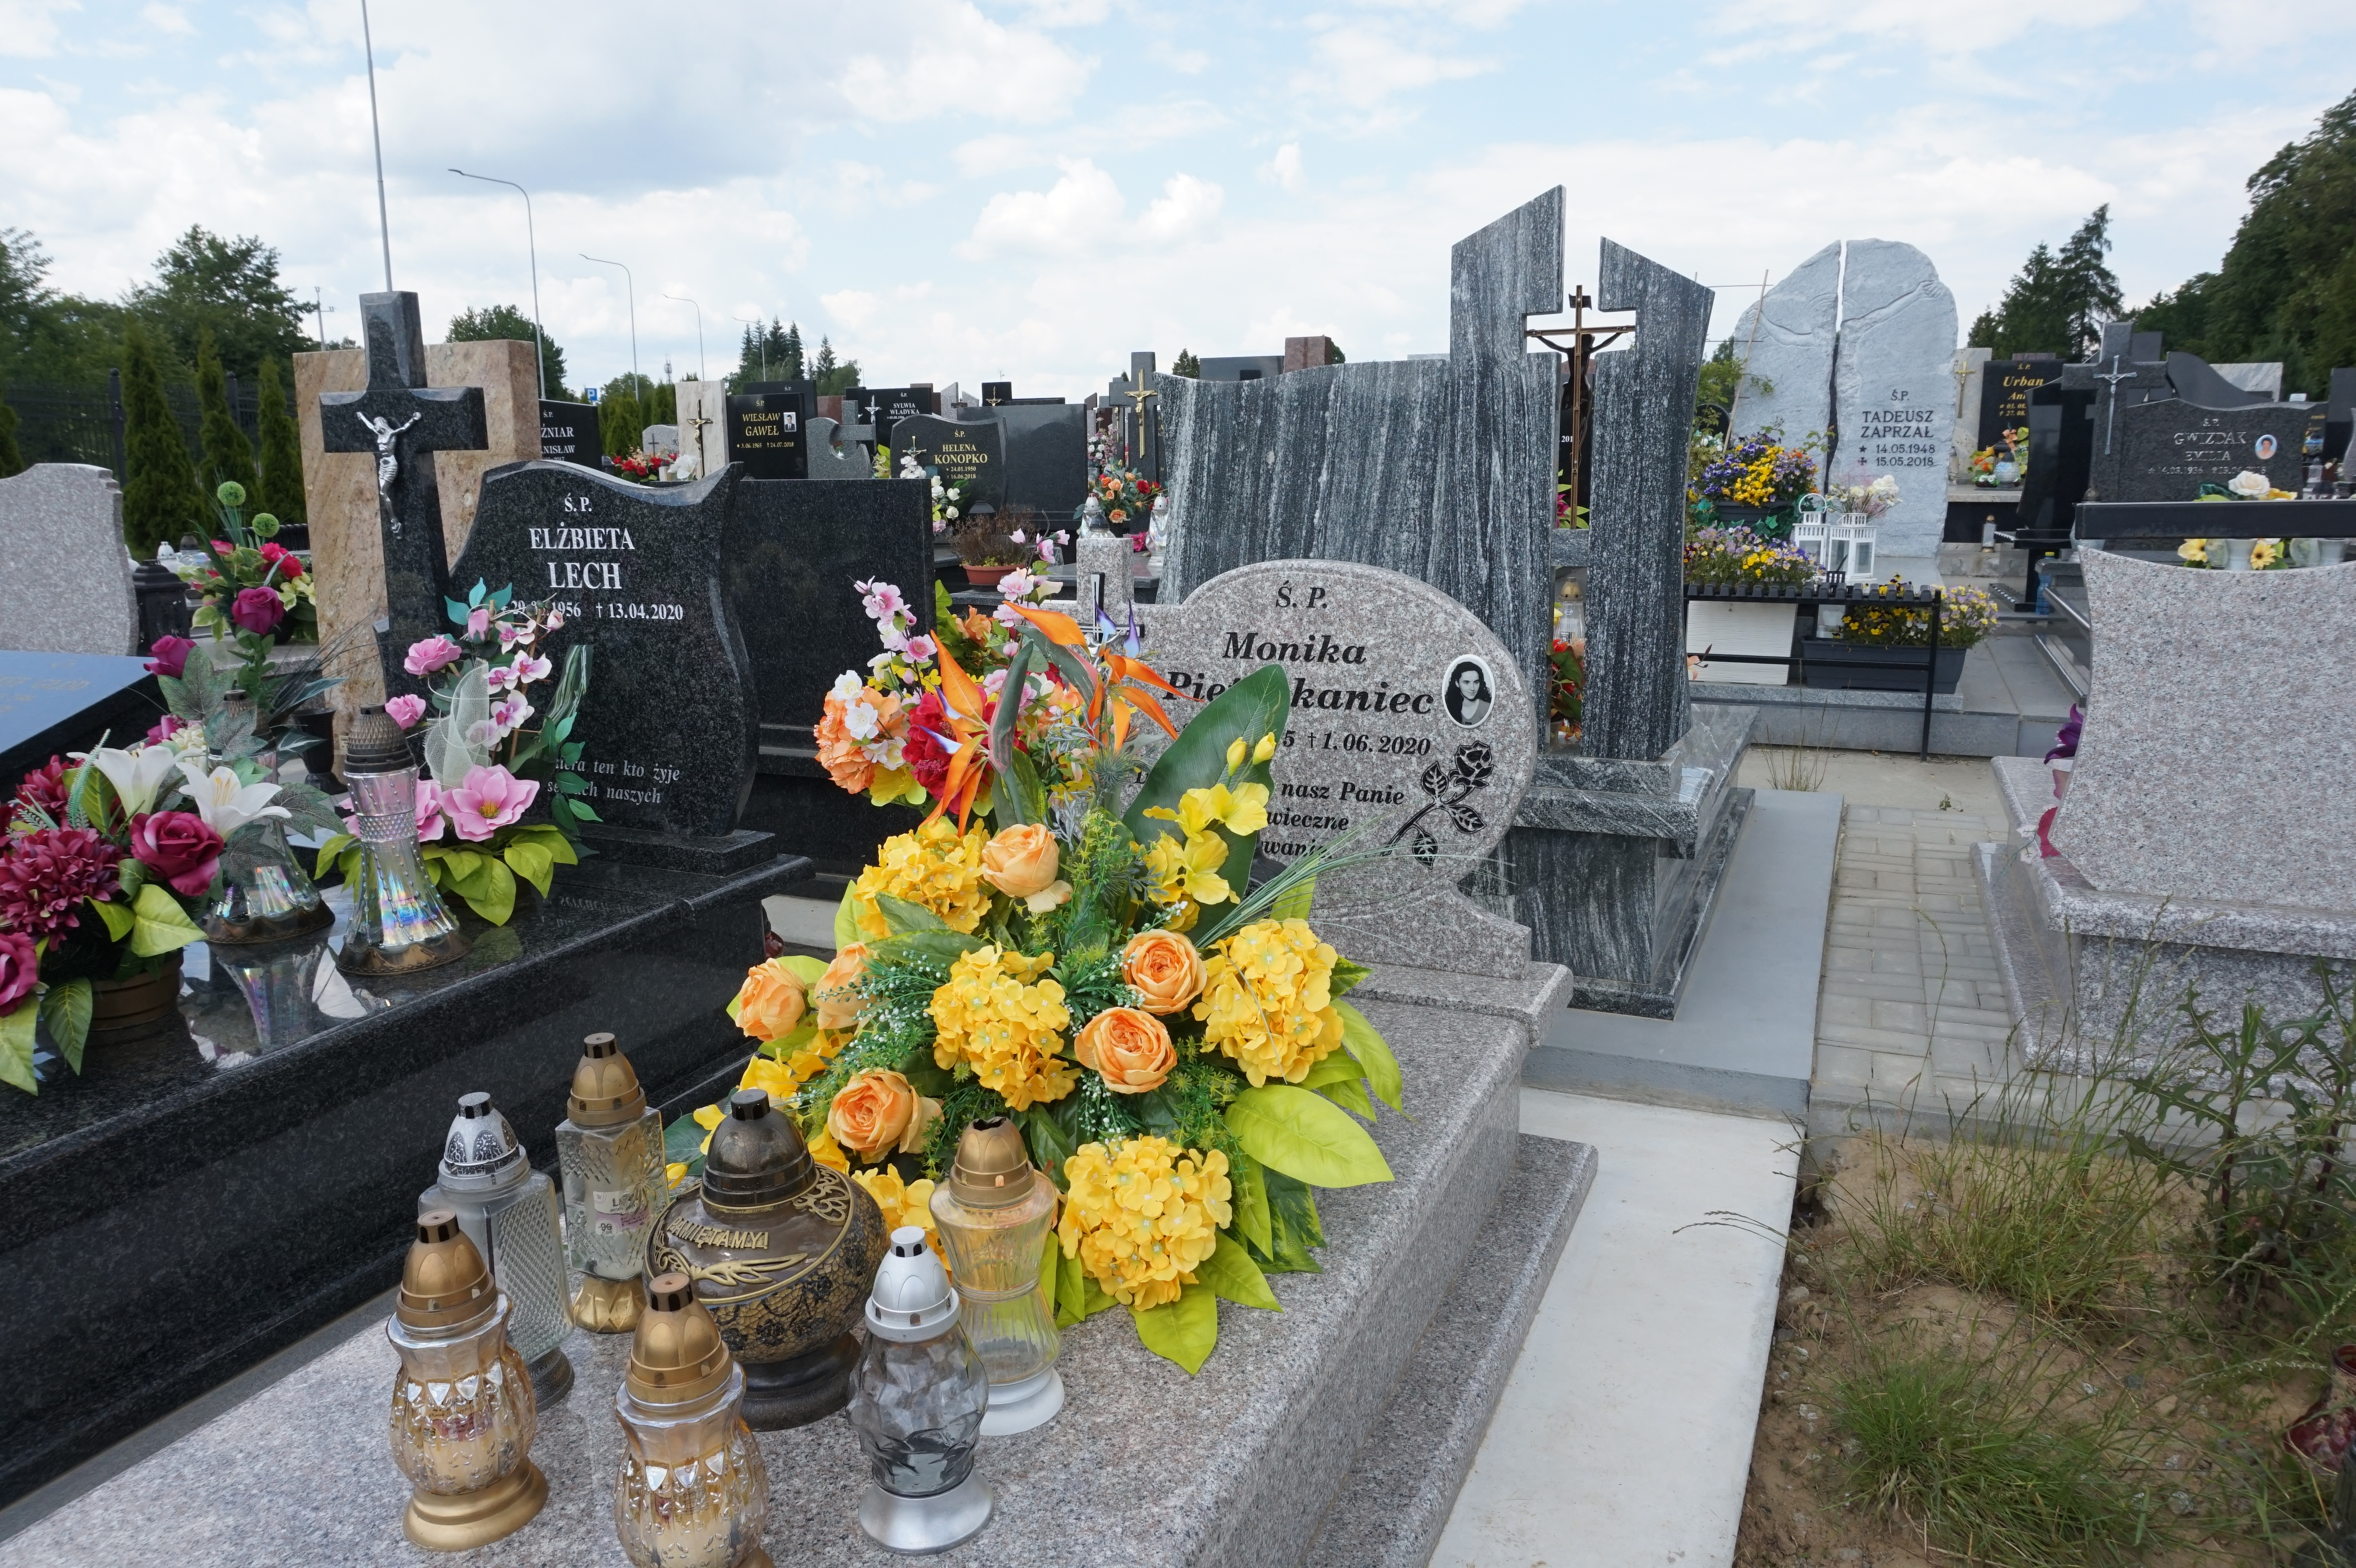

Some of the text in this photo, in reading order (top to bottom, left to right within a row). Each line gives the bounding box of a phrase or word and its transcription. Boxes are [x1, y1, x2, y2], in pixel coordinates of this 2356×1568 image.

[2003, 376, 2044, 387] Urban
[587, 389, 595, 399] P
[742, 412, 780, 422] WIESŁAW
[1862, 410, 1934, 423] TADEUSZ
[745, 425, 779, 436] GAWEŁ
[1860, 426, 1934, 438] ZAPRZAŁ
[2173, 431, 2248, 446] GWIZDAK
[541, 445, 576, 454] NISŁAW
[942, 444, 977, 452] HELENA
[1875, 444, 1935, 454] 14.05.1948
[934, 453, 988, 464] KONOPKO
[1875, 457, 1934, 466] 15.05.2018
[2184, 450, 2232, 462] EMILIA
[529, 521, 636, 550] ELŻBIETA
[547, 562, 623, 589] LECH
[608, 602, 684, 620] 13.04.2020
[1222, 632, 1367, 664] Monika
[594, 759, 614, 775] ten
[623, 760, 645, 778] kto
[652, 763, 681, 784] żyje
[606, 786, 662, 806] naszych
[1281, 781, 1406, 806] nasz Panie
[666, 1215, 769, 1249] PAMIĘTAMY!
